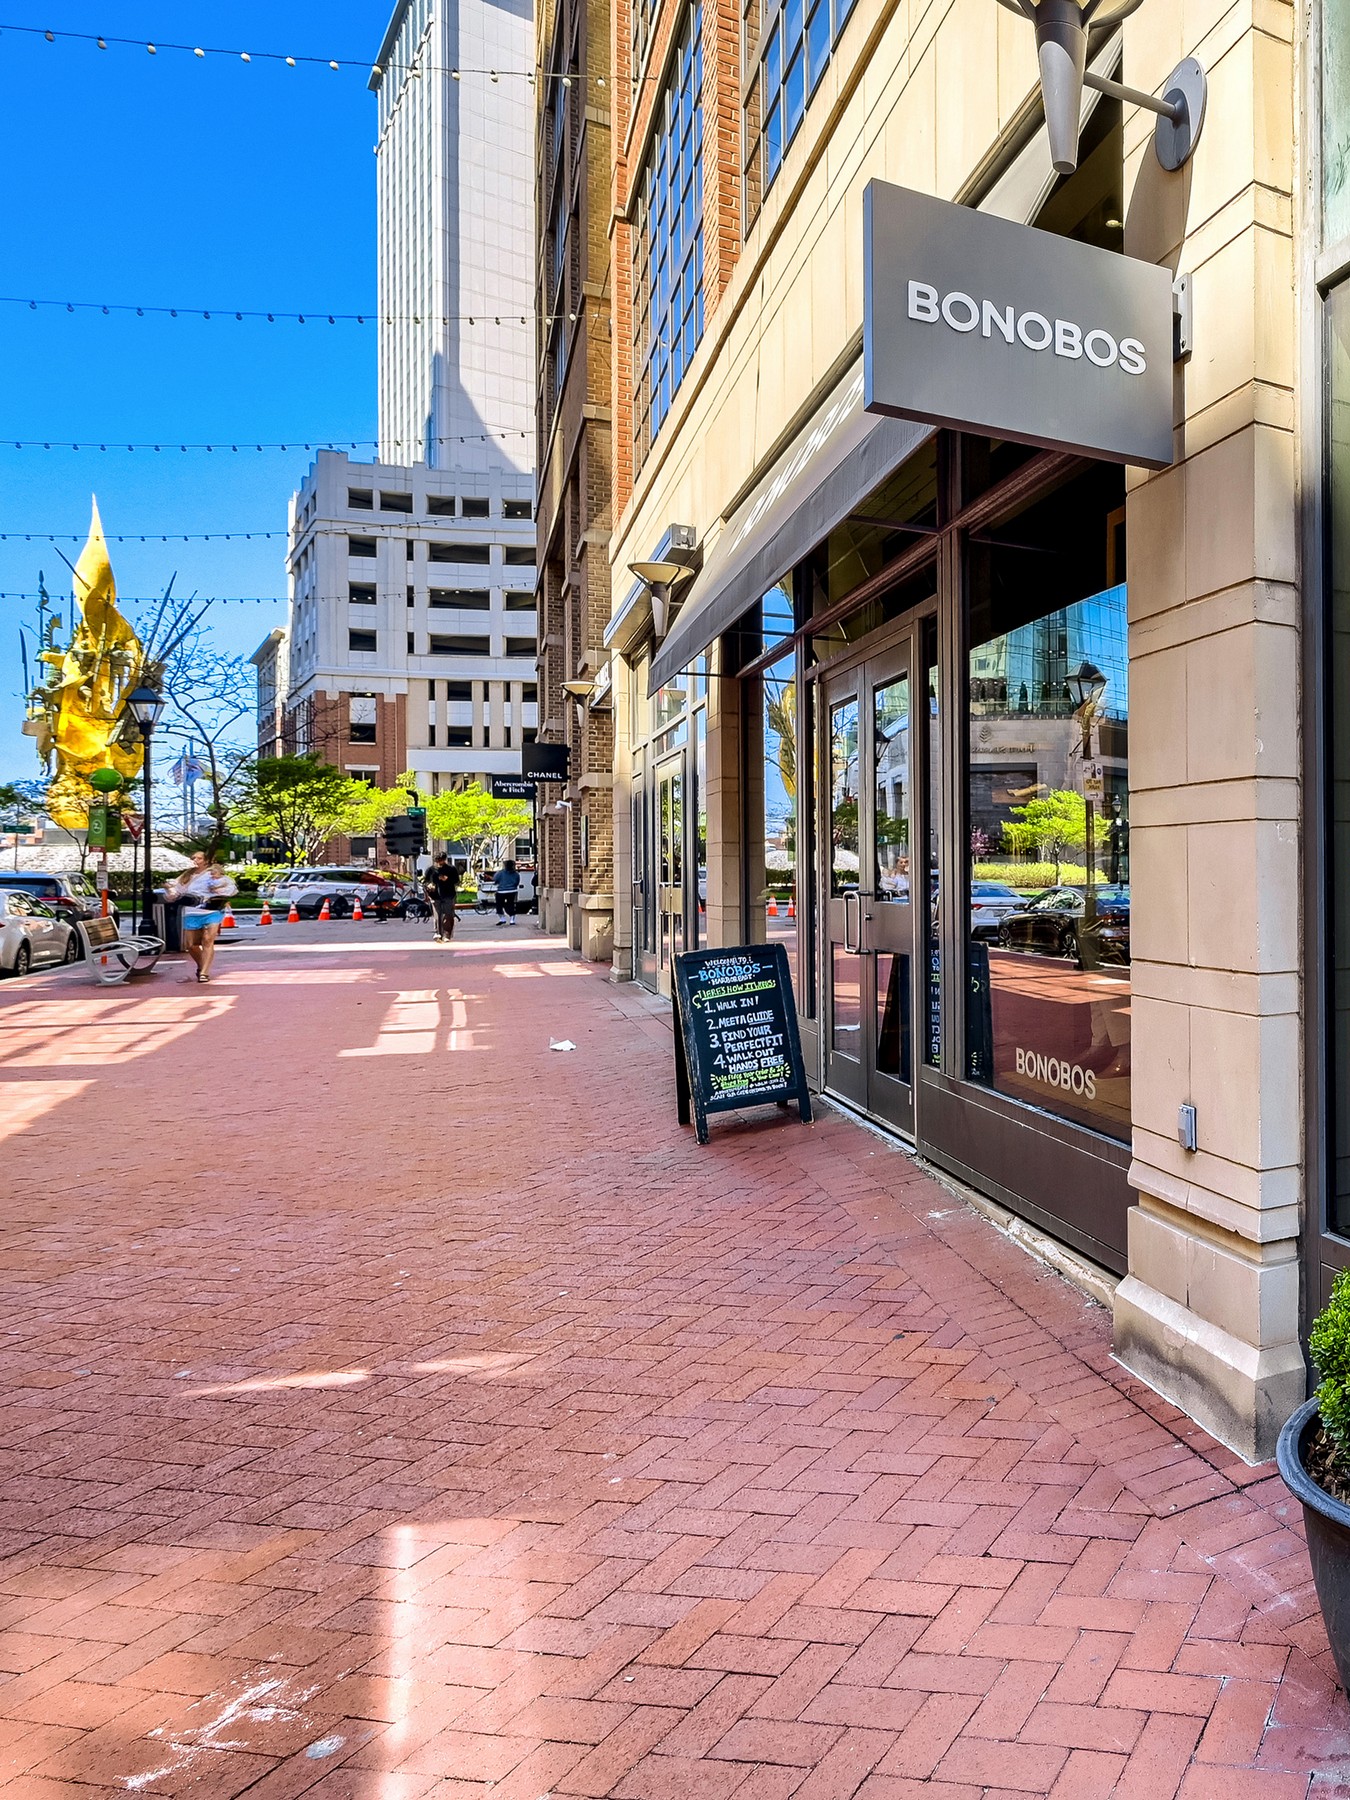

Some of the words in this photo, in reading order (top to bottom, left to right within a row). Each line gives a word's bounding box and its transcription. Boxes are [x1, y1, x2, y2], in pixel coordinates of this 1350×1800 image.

[907, 279, 1147, 375] BONOBOS
[728, 372, 864, 557] BONOBO
[494, 780, 534, 788] Abercrombie
[527, 771, 562, 779] CHANEL
[698, 963, 761, 981] BONOBOS
[716, 1000, 738, 1011] WALK
[718, 1014, 740, 1028] MEET
[746, 1009, 774, 1025] GUIDE
[721, 1030, 746, 1042] FIND
[746, 1025, 772, 1038] YOUR
[724, 1038, 765, 1053] PERFECT
[765, 1034, 783, 1046] FIT
[726, 1052, 754, 1064] WALK
[755, 1048, 775, 1059] OUT
[728, 1059, 759, 1074] HANDS
[760, 1054, 784, 1068] FREE
[1015, 1047, 1097, 1100] BONOBOS
